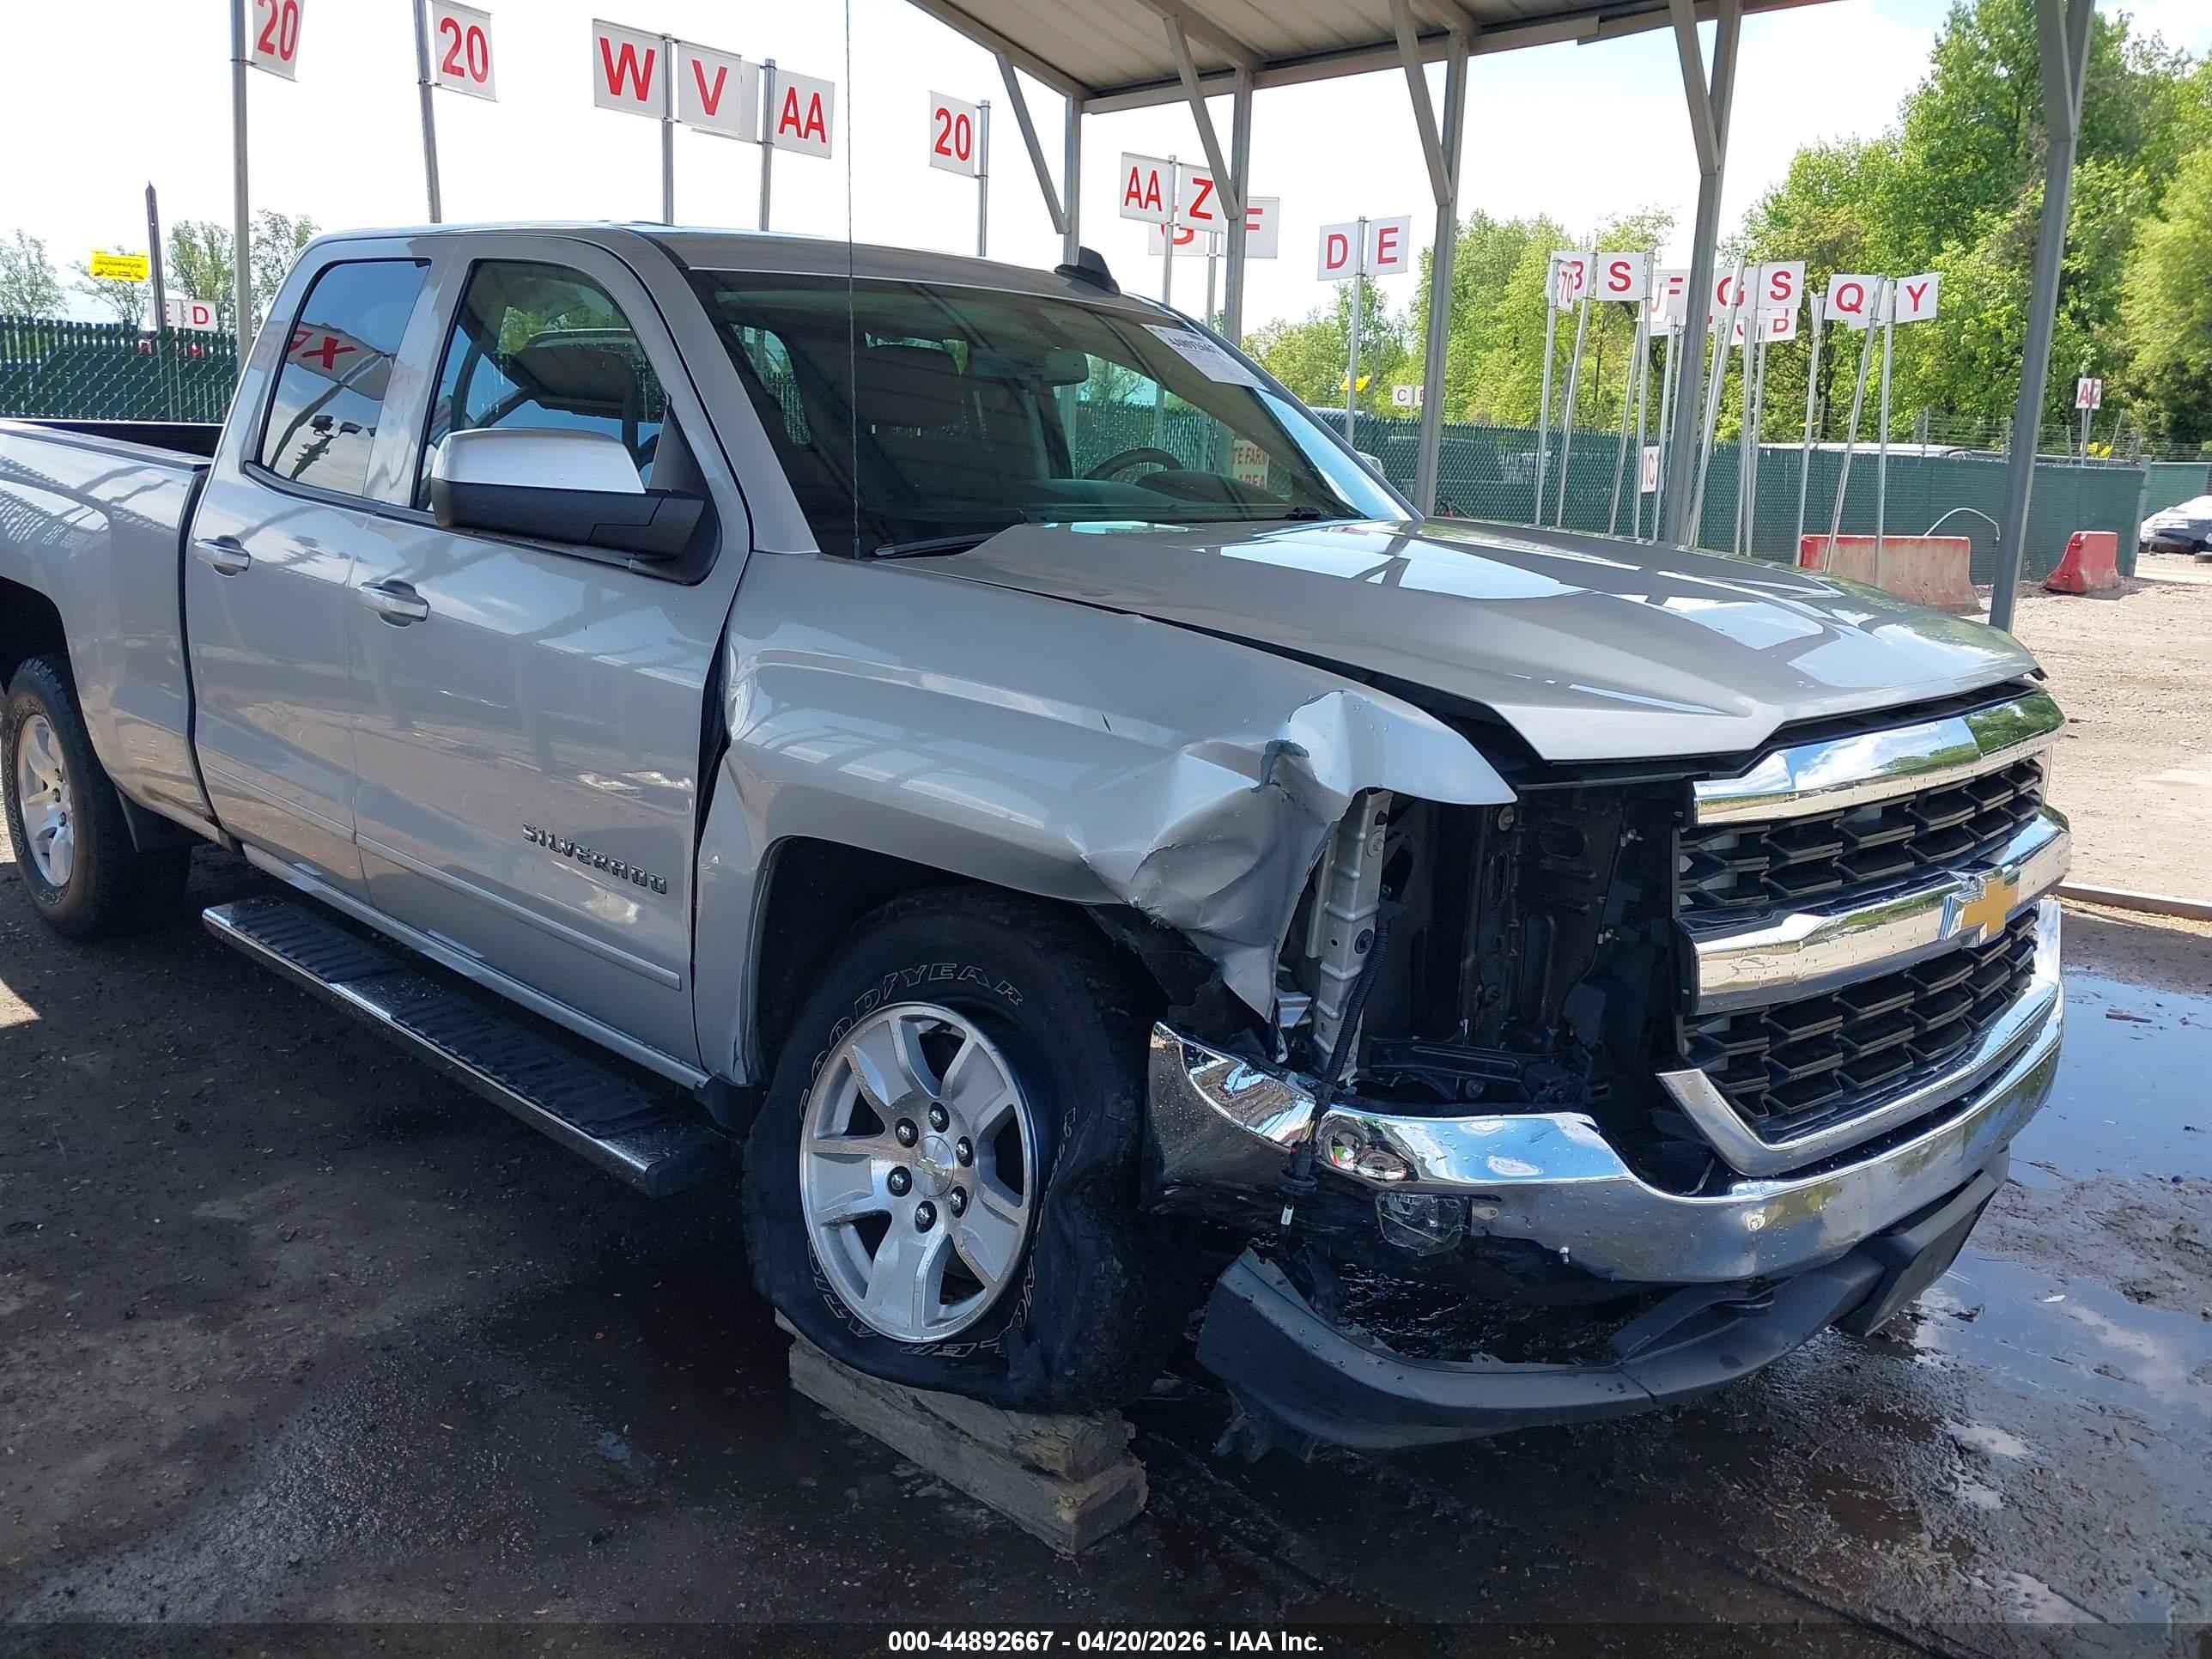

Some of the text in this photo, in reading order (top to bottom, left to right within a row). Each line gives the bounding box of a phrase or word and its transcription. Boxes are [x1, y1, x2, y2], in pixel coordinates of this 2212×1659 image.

[257, 0, 299, 61] 20
[440, 17, 489, 83] 20
[599, 36, 656, 102] W
[691, 59, 728, 116] V
[778, 86, 827, 143] AA
[934, 107, 971, 161] 20
[1124, 167, 1162, 212] AA
[1189, 178, 1213, 220] Z
[1327, 234, 1348, 270] D
[1377, 227, 1399, 264] E
[1608, 261, 1632, 291] S
[1769, 270, 1792, 301] S
[1905, 282, 1929, 313] Y
[192, 306, 210, 325] D
[1836, 283, 1865, 314] Q
[522, 822, 667, 895] SILVERADO
